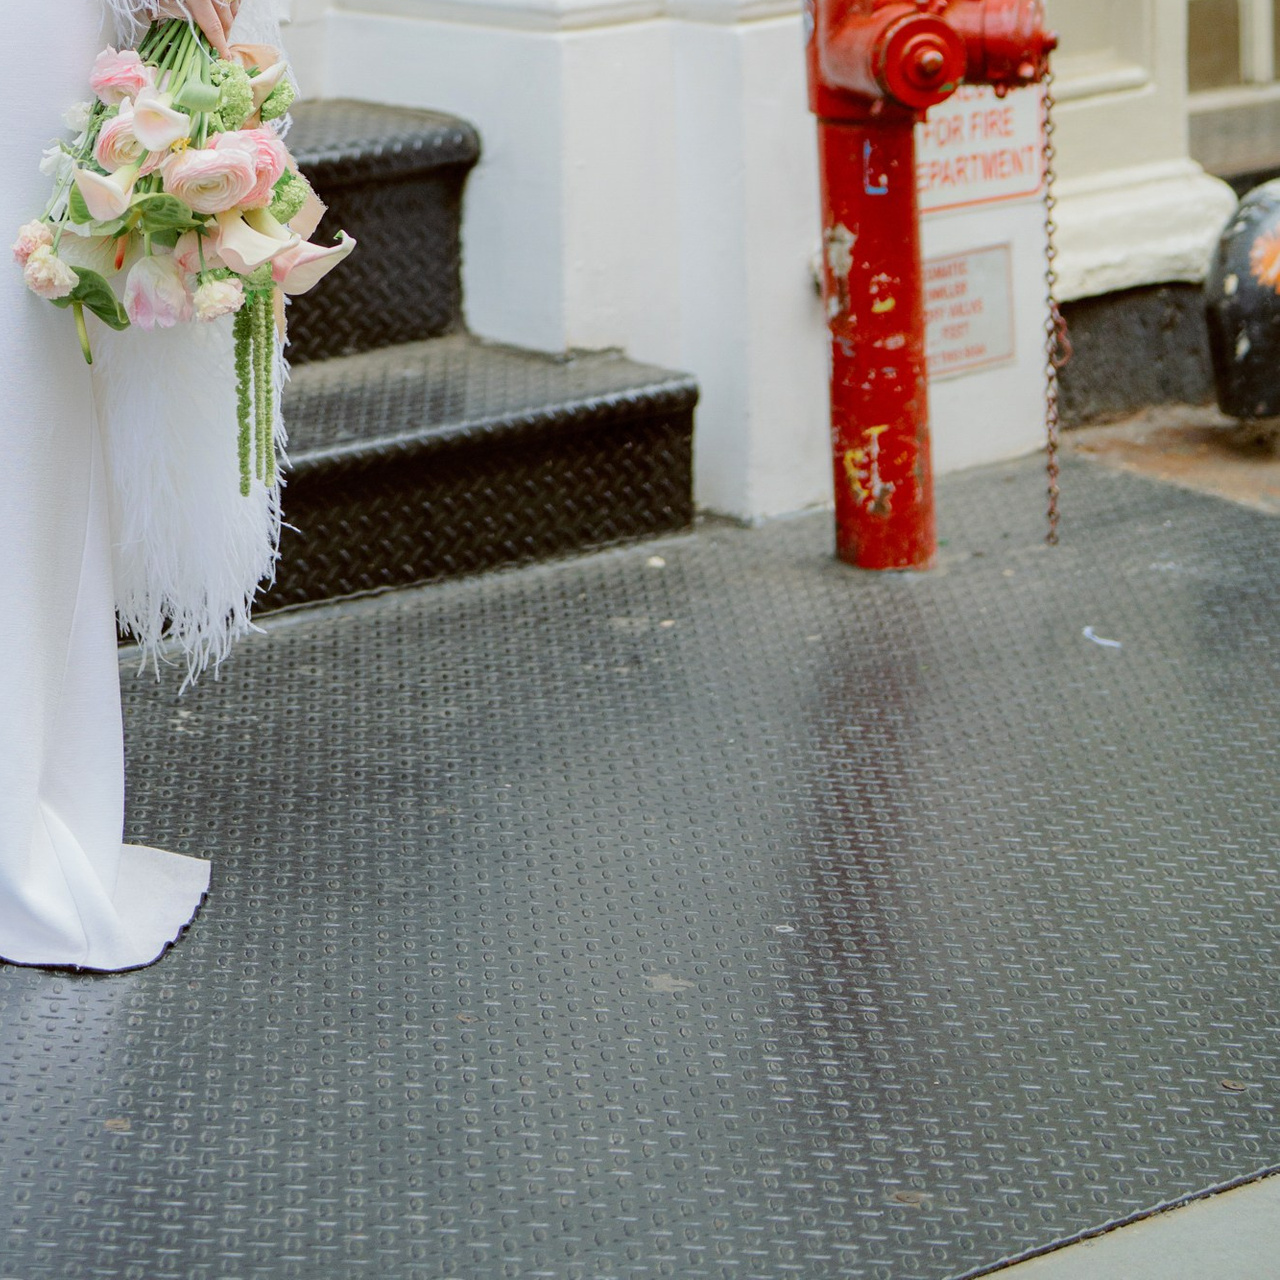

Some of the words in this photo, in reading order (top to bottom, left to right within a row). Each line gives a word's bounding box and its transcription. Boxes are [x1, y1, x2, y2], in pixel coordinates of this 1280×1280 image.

[922, 113, 963, 148] FOR
[970, 105, 1014, 142] FIRE
[915, 144, 1035, 193] EPARTMENT
